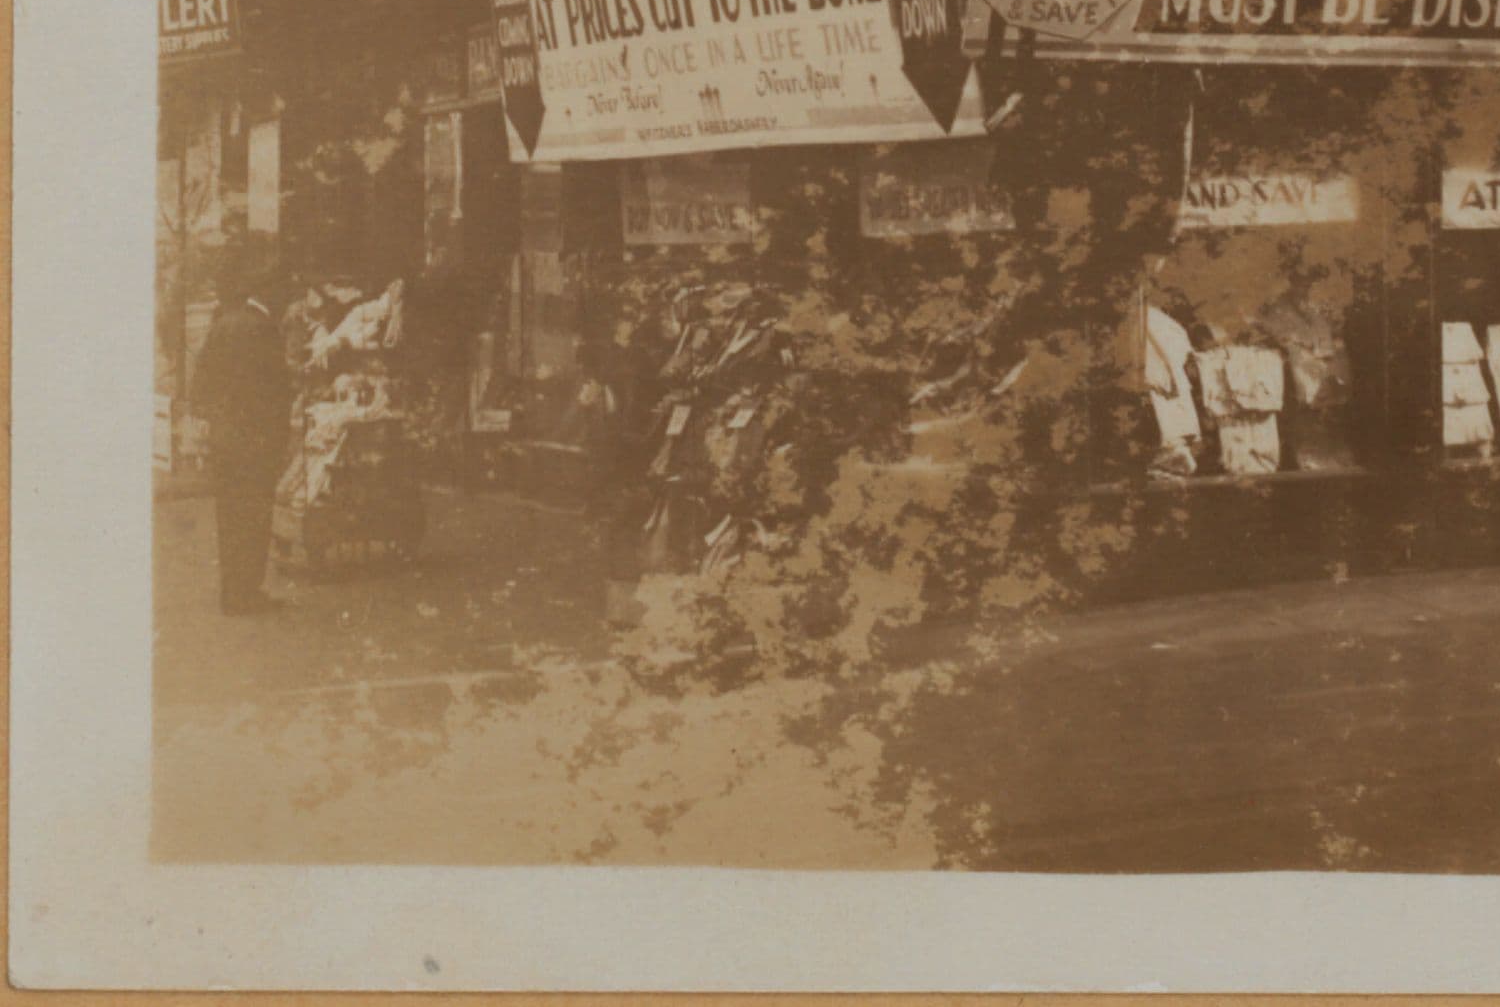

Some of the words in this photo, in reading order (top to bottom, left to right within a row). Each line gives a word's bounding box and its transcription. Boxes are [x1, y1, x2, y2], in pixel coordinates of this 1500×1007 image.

[643, 42, 698, 80] ONCE
[707, 40, 732, 71] IN
[733, 36, 747, 66] A
[756, 26, 806, 63] LIFE
[820, 18, 883, 57] TIME
